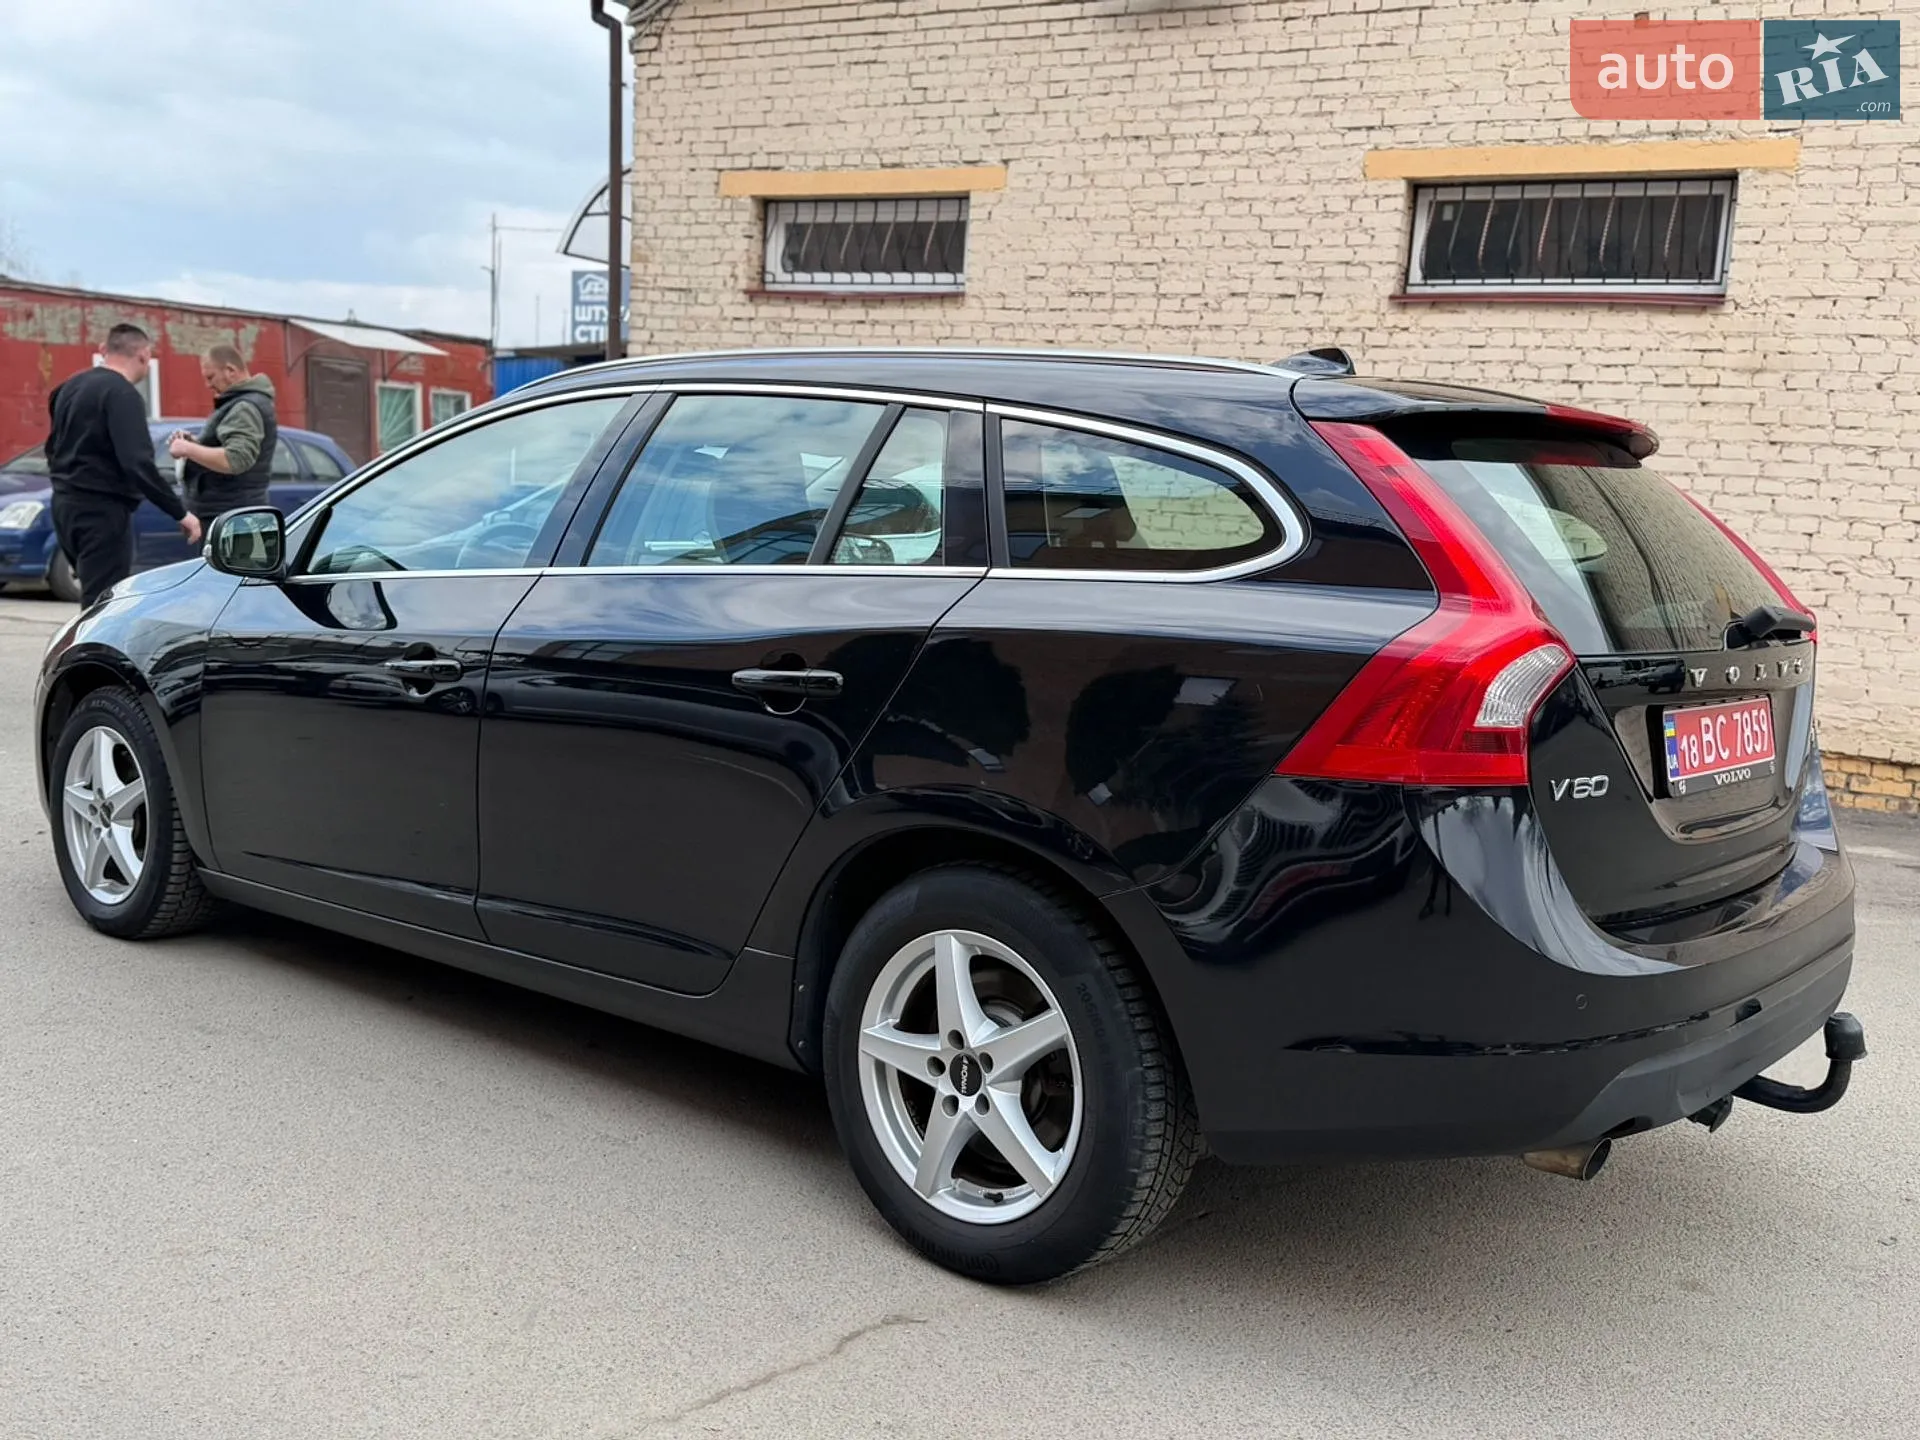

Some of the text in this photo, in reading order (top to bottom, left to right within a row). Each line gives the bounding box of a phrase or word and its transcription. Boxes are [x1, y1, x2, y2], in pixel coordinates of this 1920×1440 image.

[1689, 658, 1803, 688] VOLVO
[1680, 708, 1769, 770] 18 BC 7859
[1549, 774, 1610, 802] V60
[1714, 768, 1752, 786] VOLVO
